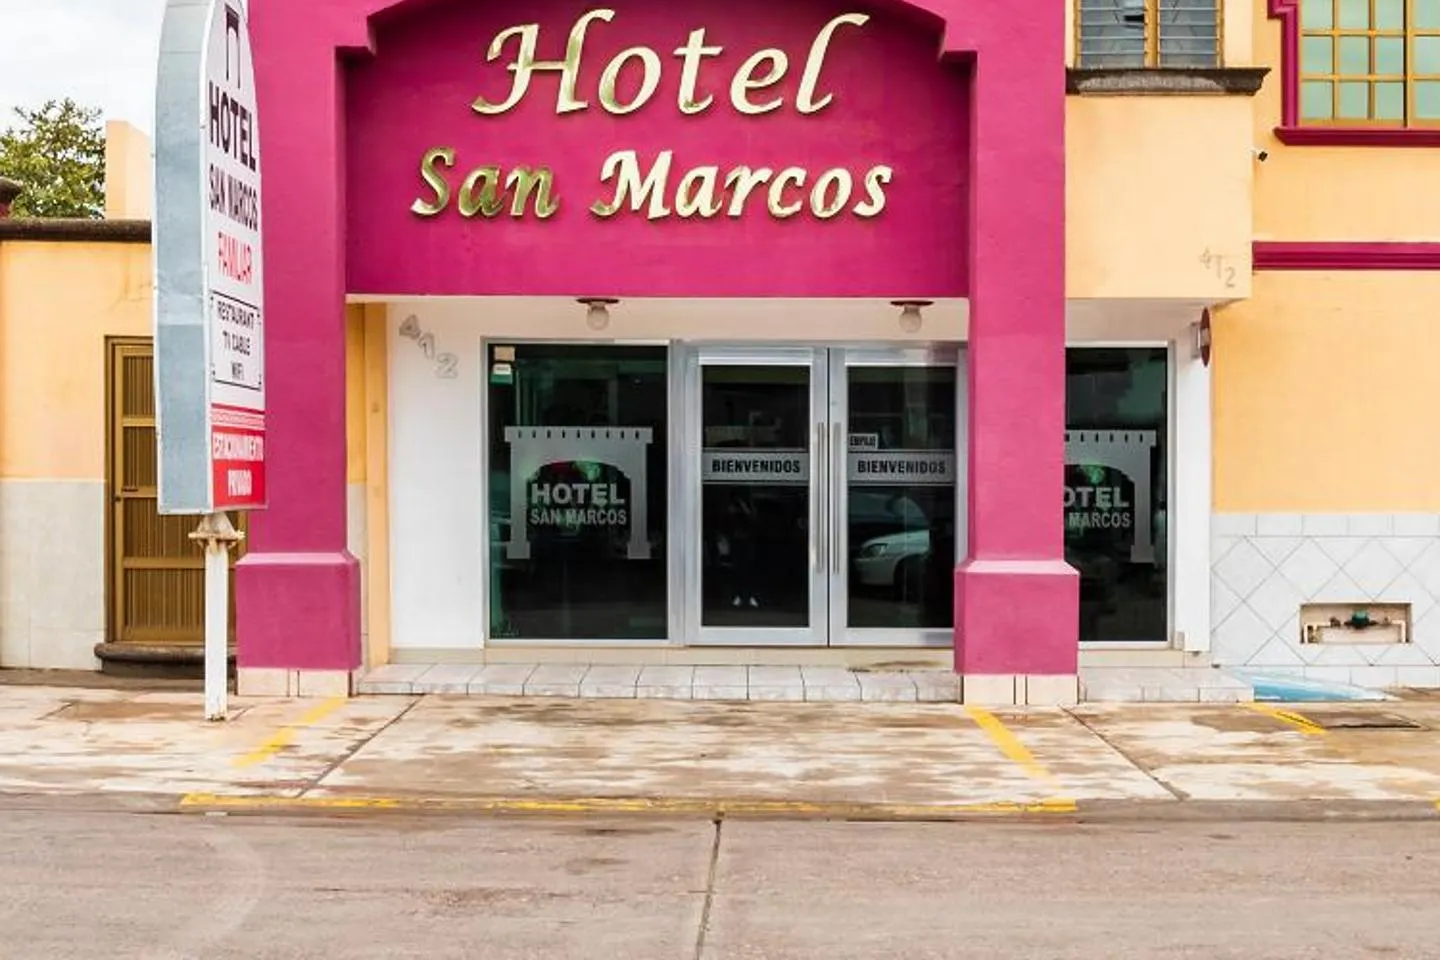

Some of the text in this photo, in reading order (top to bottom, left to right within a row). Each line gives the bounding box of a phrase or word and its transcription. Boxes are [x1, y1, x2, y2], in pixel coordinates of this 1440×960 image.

[470, 7, 870, 115] Hotel
[208, 79, 256, 172] HOTEL
[208, 162, 258, 232] SAN MARCOS
[410, 145, 894, 220] San Marcos
[1199, 246, 1236, 288] 412
[398, 313, 460, 380] 412
[711, 459, 801, 474] BIENVENIDOS
[857, 459, 947, 475] BIENVENIDOS
[531, 482, 626, 505] HOTEL
[1063, 486, 1130, 508] OTEL
[530, 507, 628, 526] SAN MARCOS
[1068, 511, 1131, 528] MARCOS
